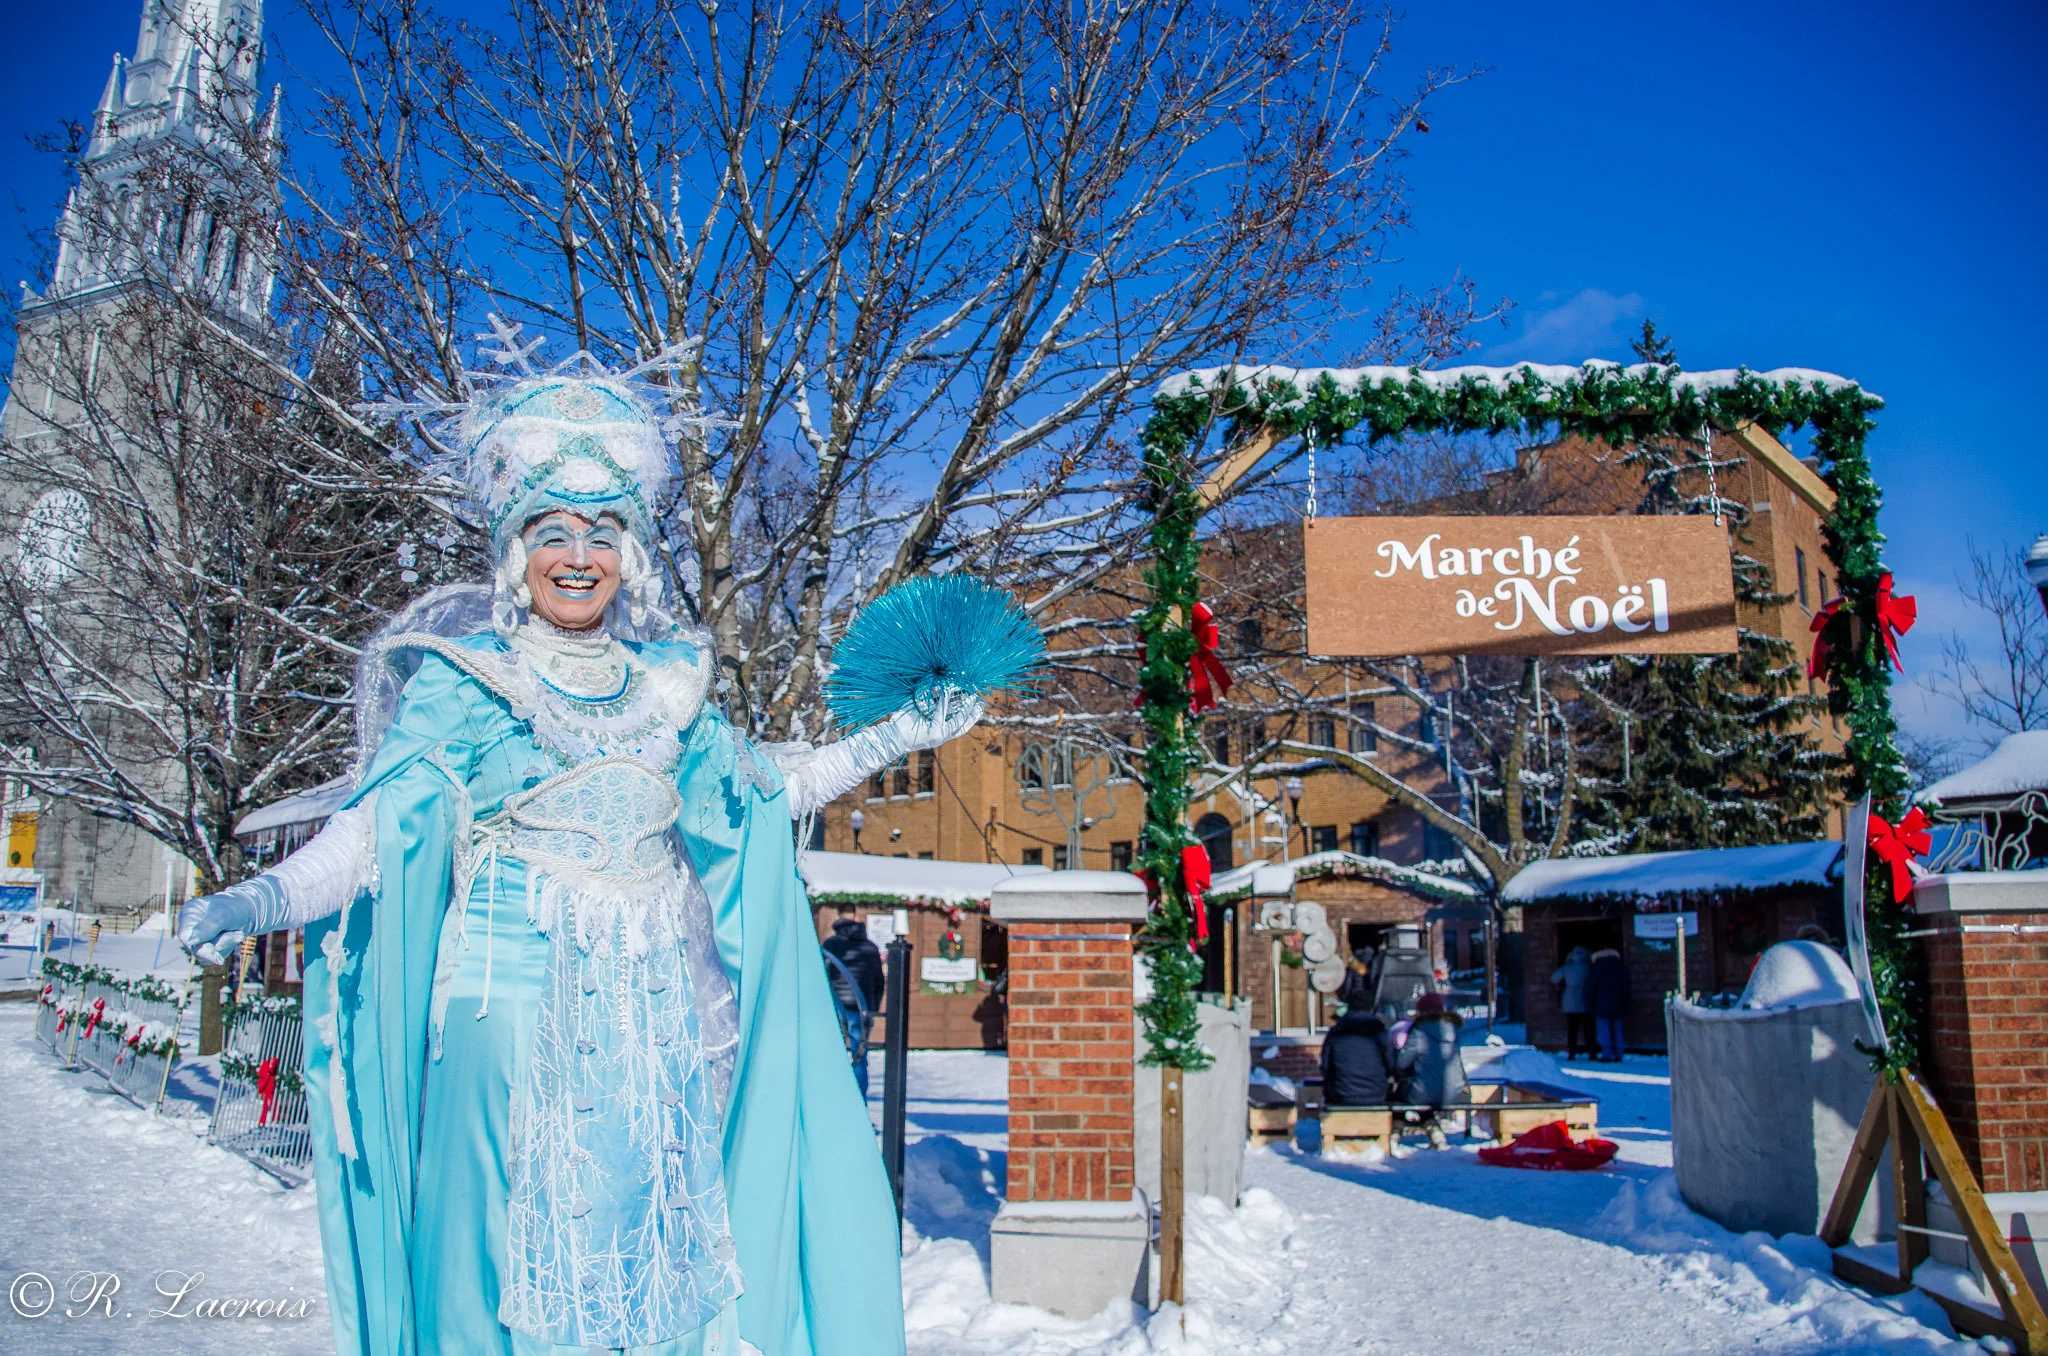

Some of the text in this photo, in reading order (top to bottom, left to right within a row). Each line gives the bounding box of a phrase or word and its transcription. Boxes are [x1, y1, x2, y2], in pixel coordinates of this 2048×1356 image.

[1374, 533, 1583, 580] Marché
[1455, 575, 1670, 636] de Noël
